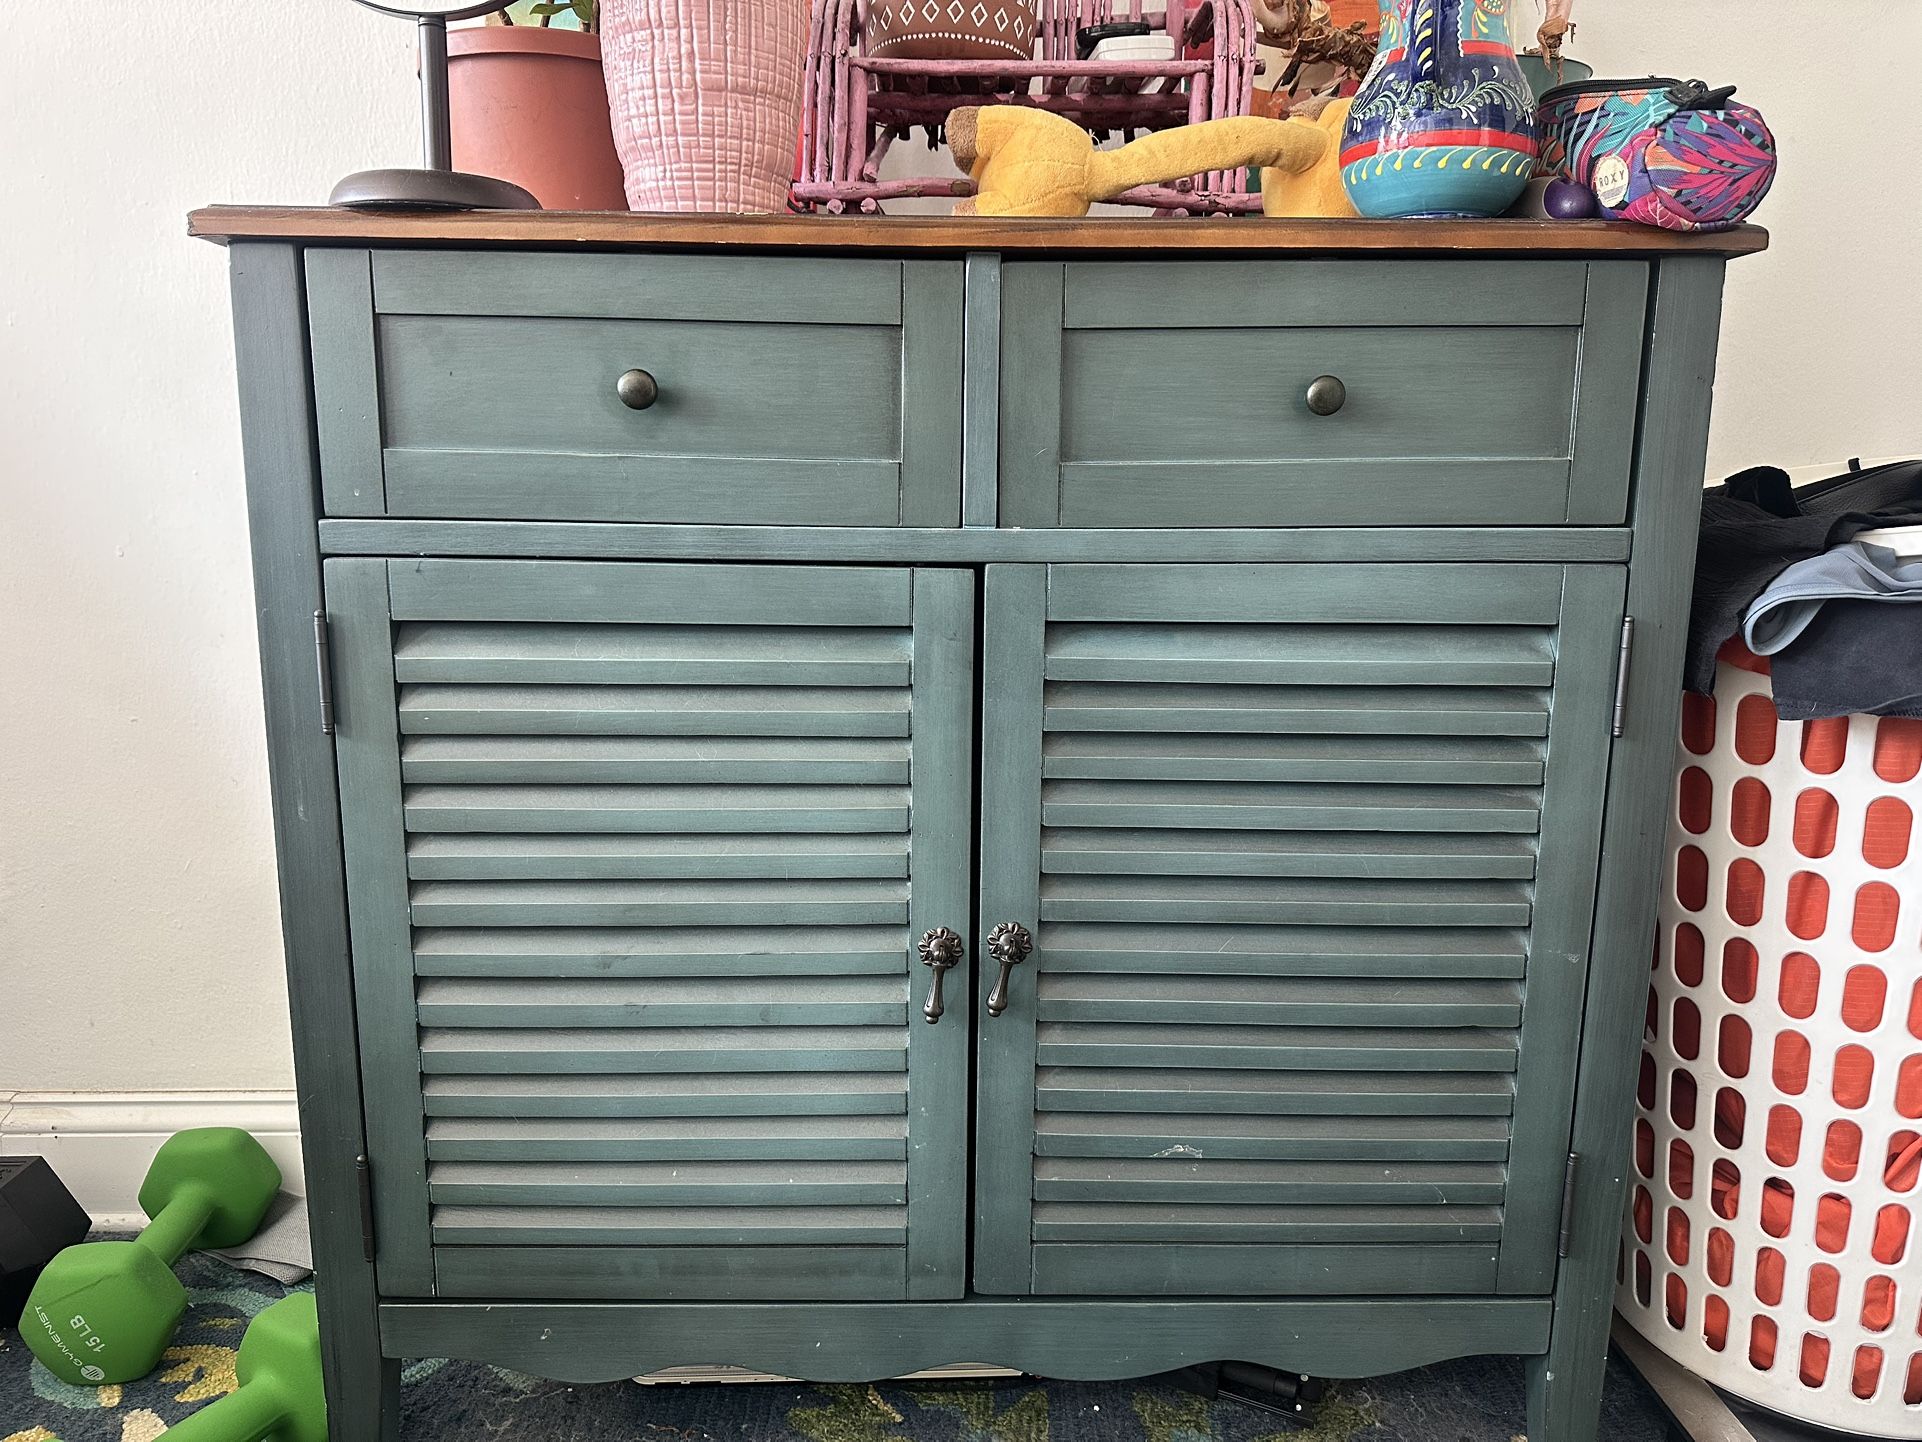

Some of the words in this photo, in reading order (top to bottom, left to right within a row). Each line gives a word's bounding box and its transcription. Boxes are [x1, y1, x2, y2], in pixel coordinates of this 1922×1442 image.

[1598, 169, 1625, 187] ROXY
[34, 1305, 83, 1367] GYMENIST
[69, 1314, 92, 1338] LB
[85, 1336, 106, 1353] 15
